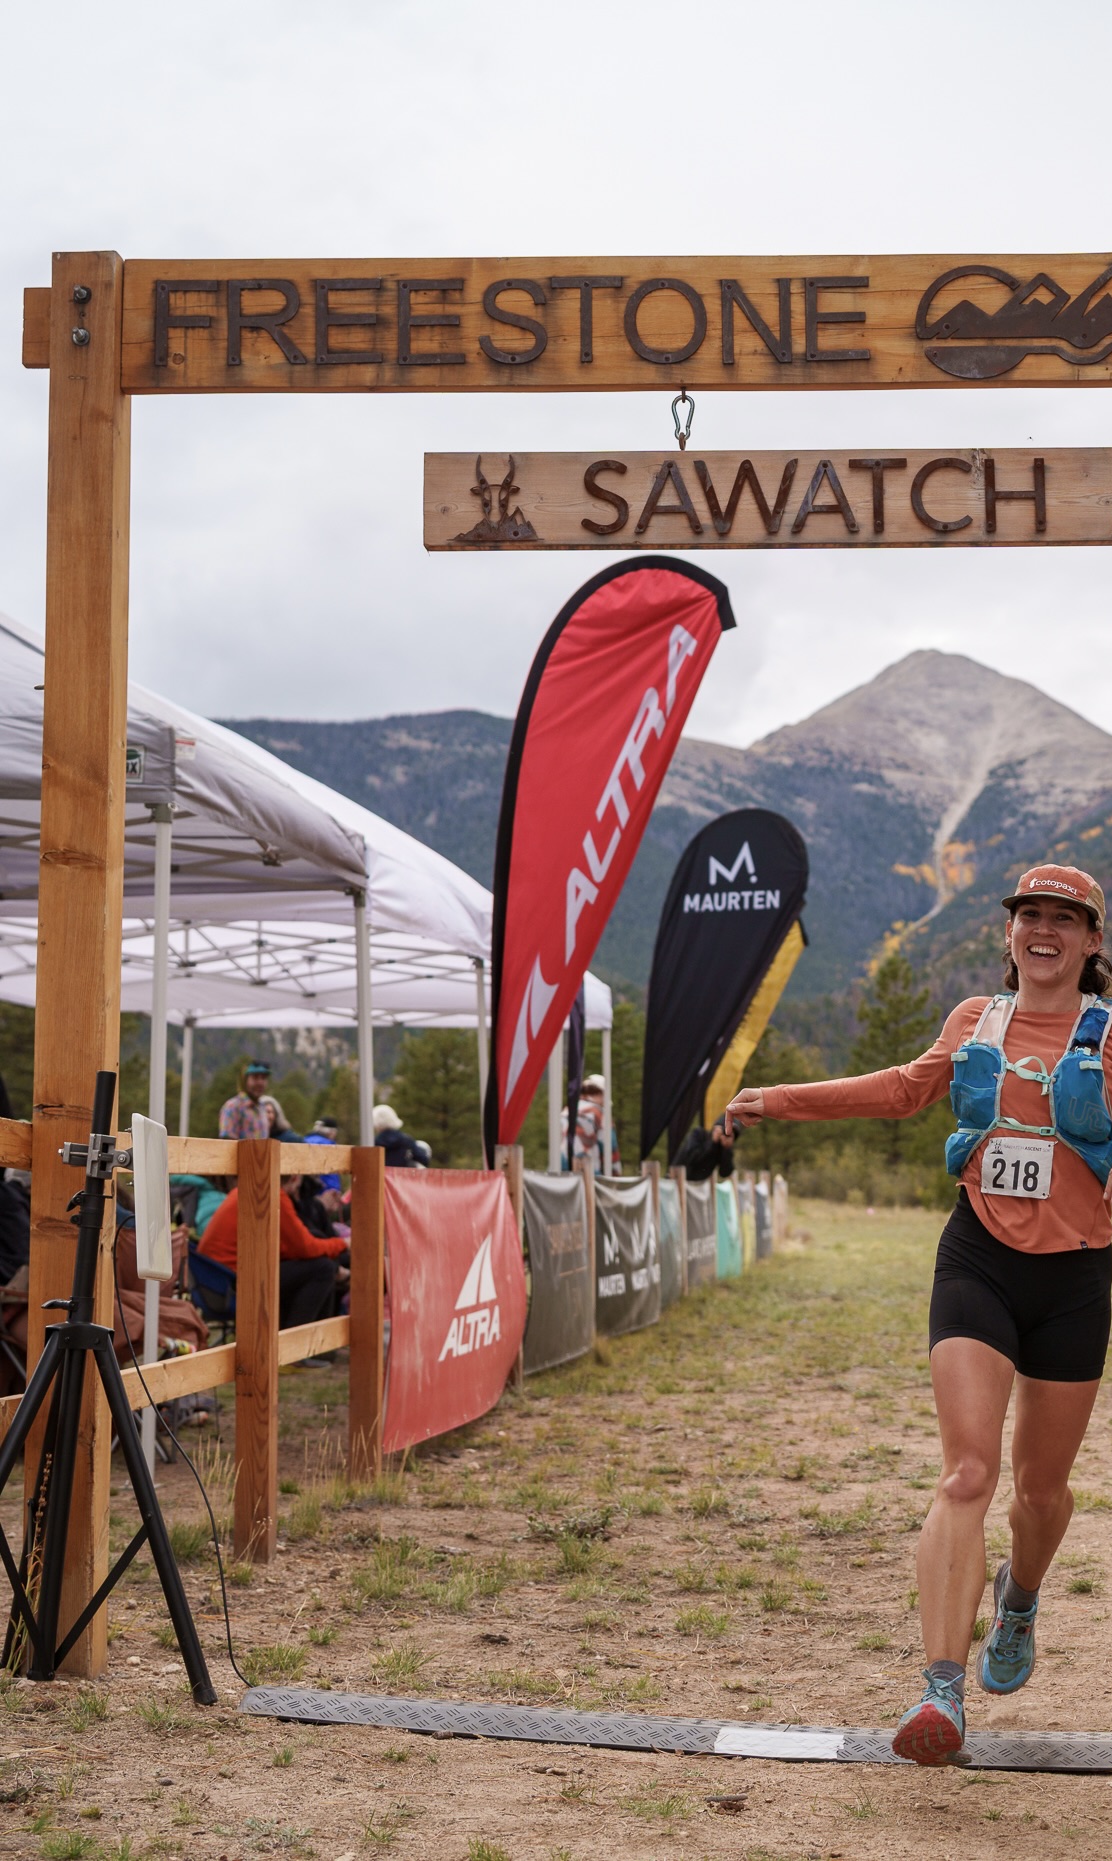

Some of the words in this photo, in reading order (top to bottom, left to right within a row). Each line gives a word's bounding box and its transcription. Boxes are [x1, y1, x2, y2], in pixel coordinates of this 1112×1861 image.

[154, 276, 871, 367] FREESTONE
[580, 457, 1046, 535] SAWATCH
[565, 624, 698, 968] ALTRA
[683, 890, 781, 914] MAURTEN
[1035, 879, 1078, 896] cotopaxi
[992, 1158, 1040, 1192] 218
[438, 1305, 501, 1362] ALTRA
